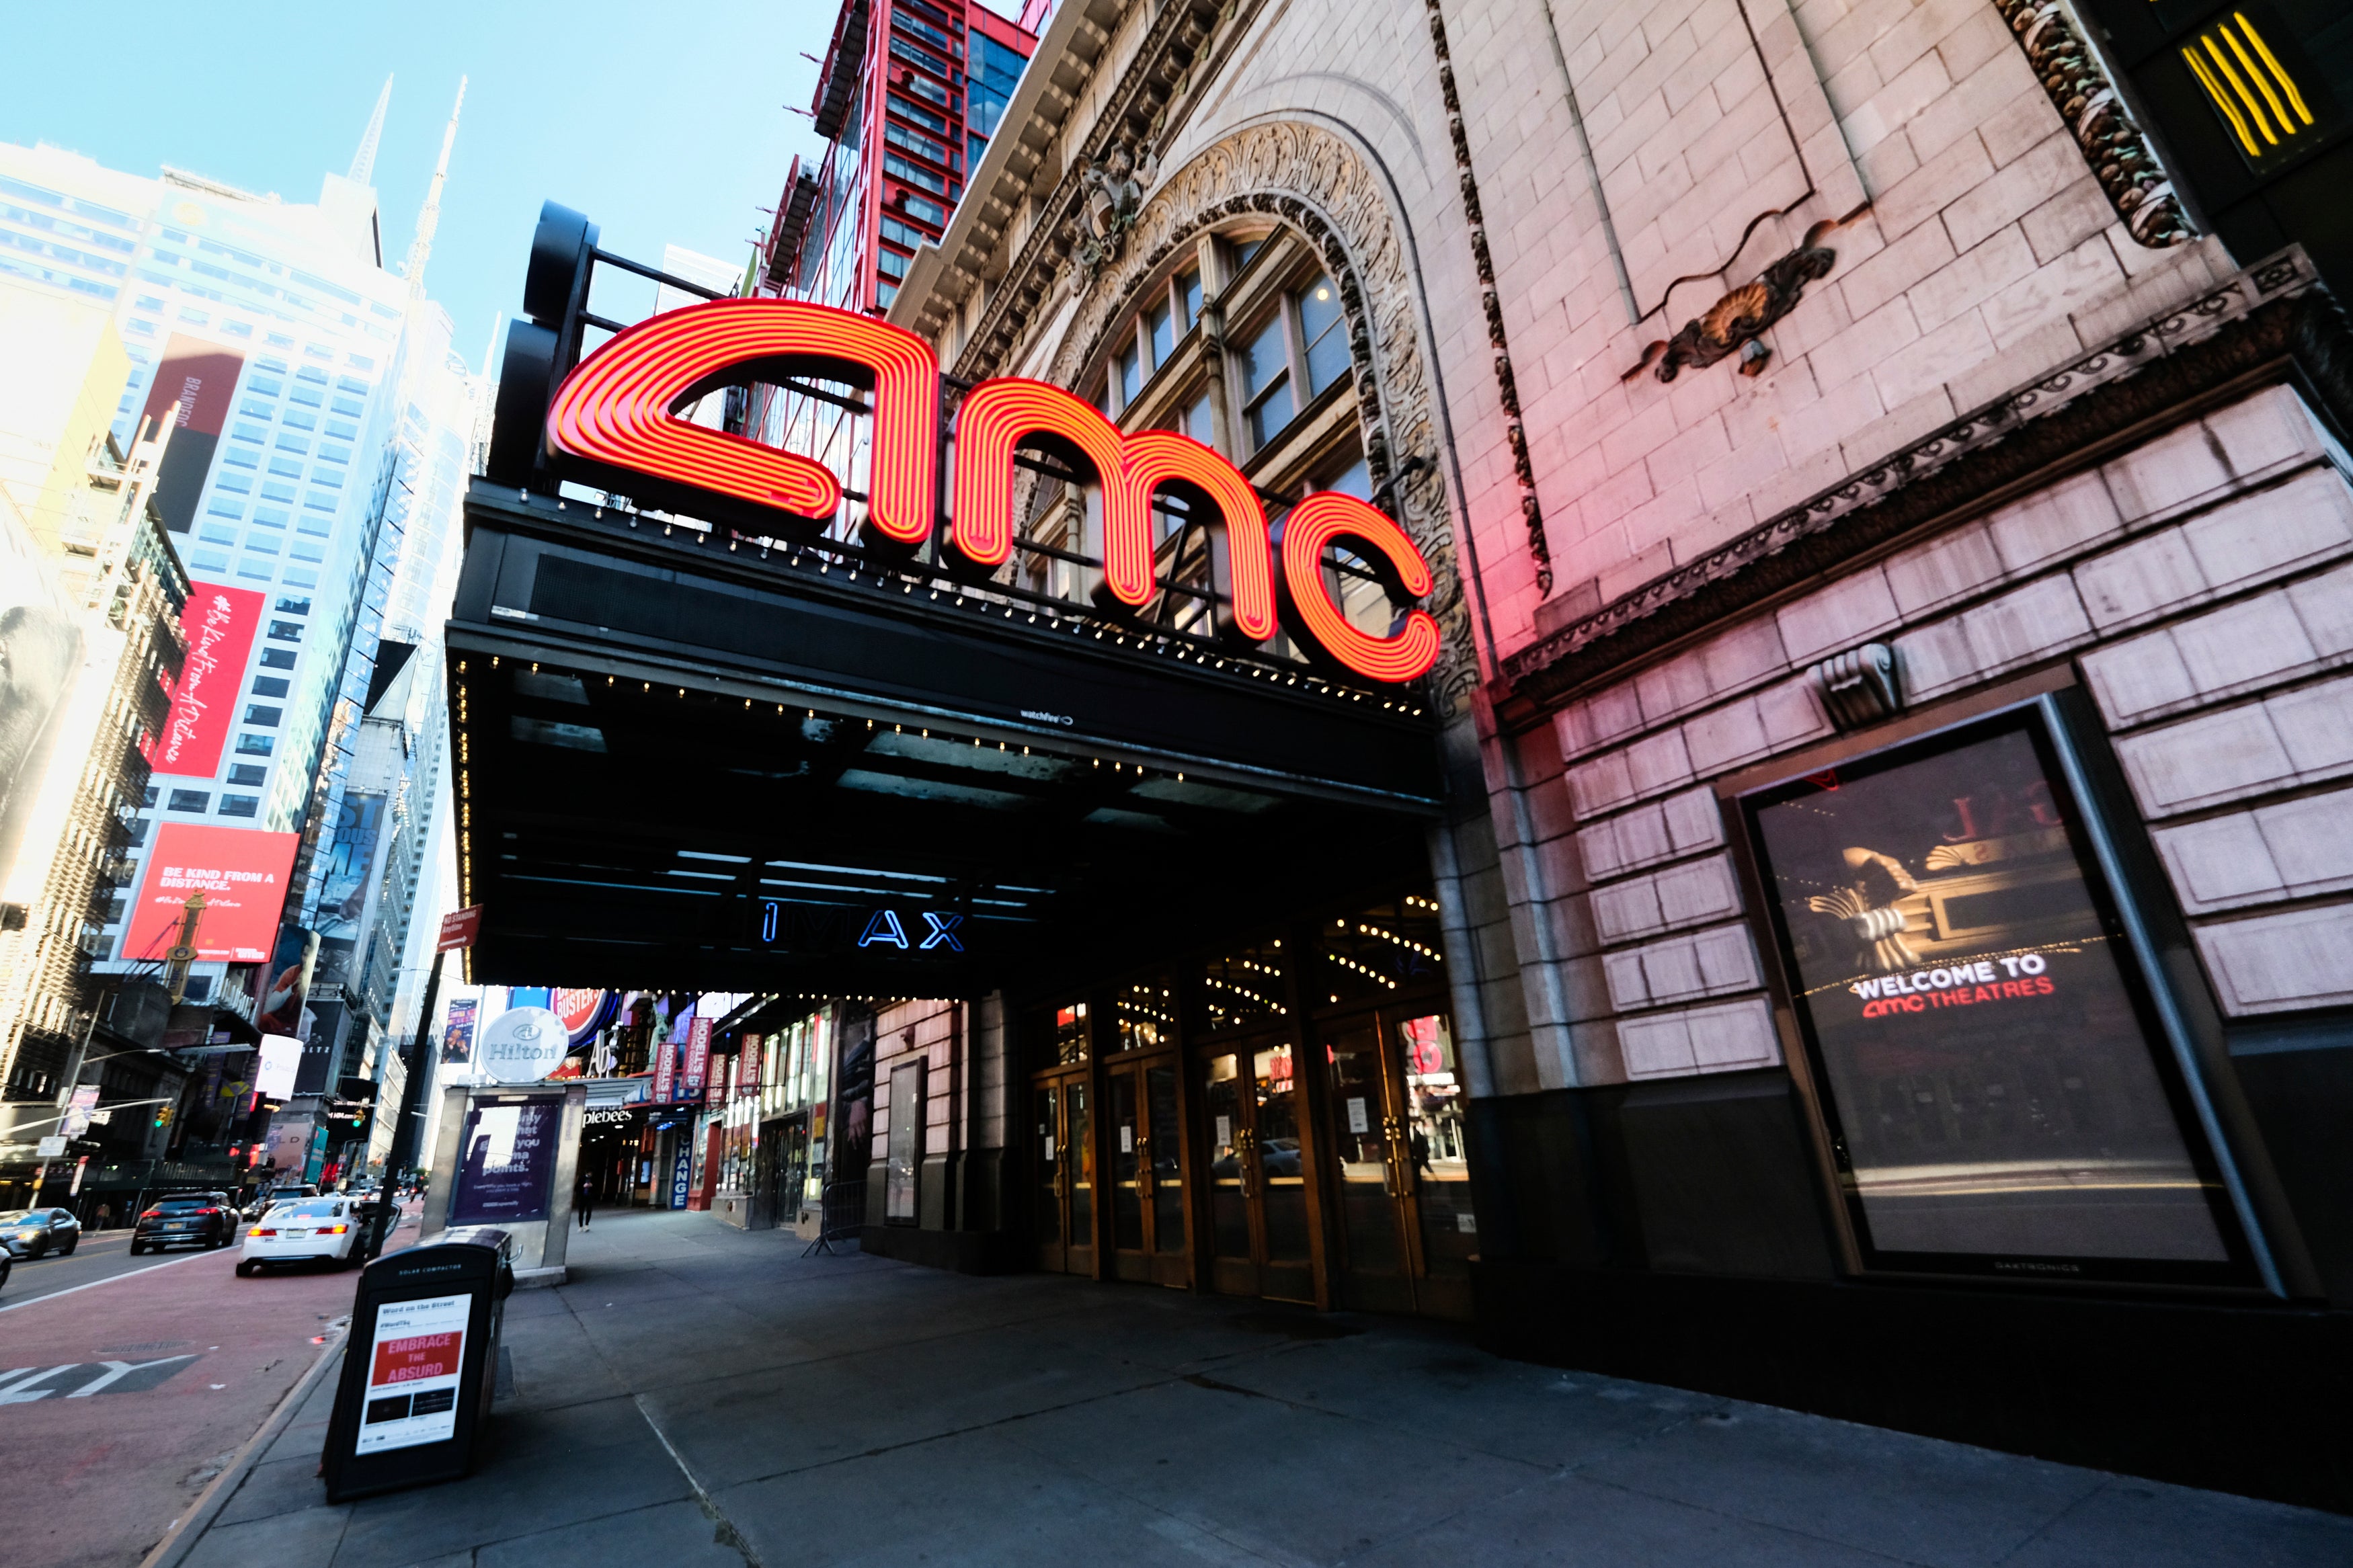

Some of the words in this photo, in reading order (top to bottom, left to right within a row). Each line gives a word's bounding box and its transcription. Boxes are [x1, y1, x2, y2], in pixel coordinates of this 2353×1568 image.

[548, 298, 1440, 682] amc
[163, 866, 183, 878] BE
[186, 868, 221, 880] KIND
[224, 870, 262, 883] FROM
[264, 873, 274, 884] A
[160, 877, 231, 891] DISTANCE.
[444, 916, 451, 924] NO
[452, 909, 477, 923] STANDING
[442, 923, 463, 934] Anytime
[1853, 960, 1996, 1000] WELCOME
[1999, 953, 2046, 978] TO
[1862, 995, 1925, 1018] amc
[1927, 976, 2055, 1008] THEATRES
[489, 1044, 557, 1060] Hilton
[693, 1018, 709, 1073] MODELL'S
[747, 1034, 760, 1083] MODELL'S
[661, 1044, 675, 1091] MODELL'S
[518, 1113, 542, 1124] nly
[516, 1126, 538, 1134] hat
[517, 1139, 541, 1149] you
[422, 1264, 461, 1274] COMPACTOR
[383, 1307, 404, 1315] Word
[432, 1300, 454, 1309] Street
[388, 1333, 452, 1354] EMBRACE
[408, 1352, 426, 1362] THE
[387, 1362, 444, 1383] ABSURD
